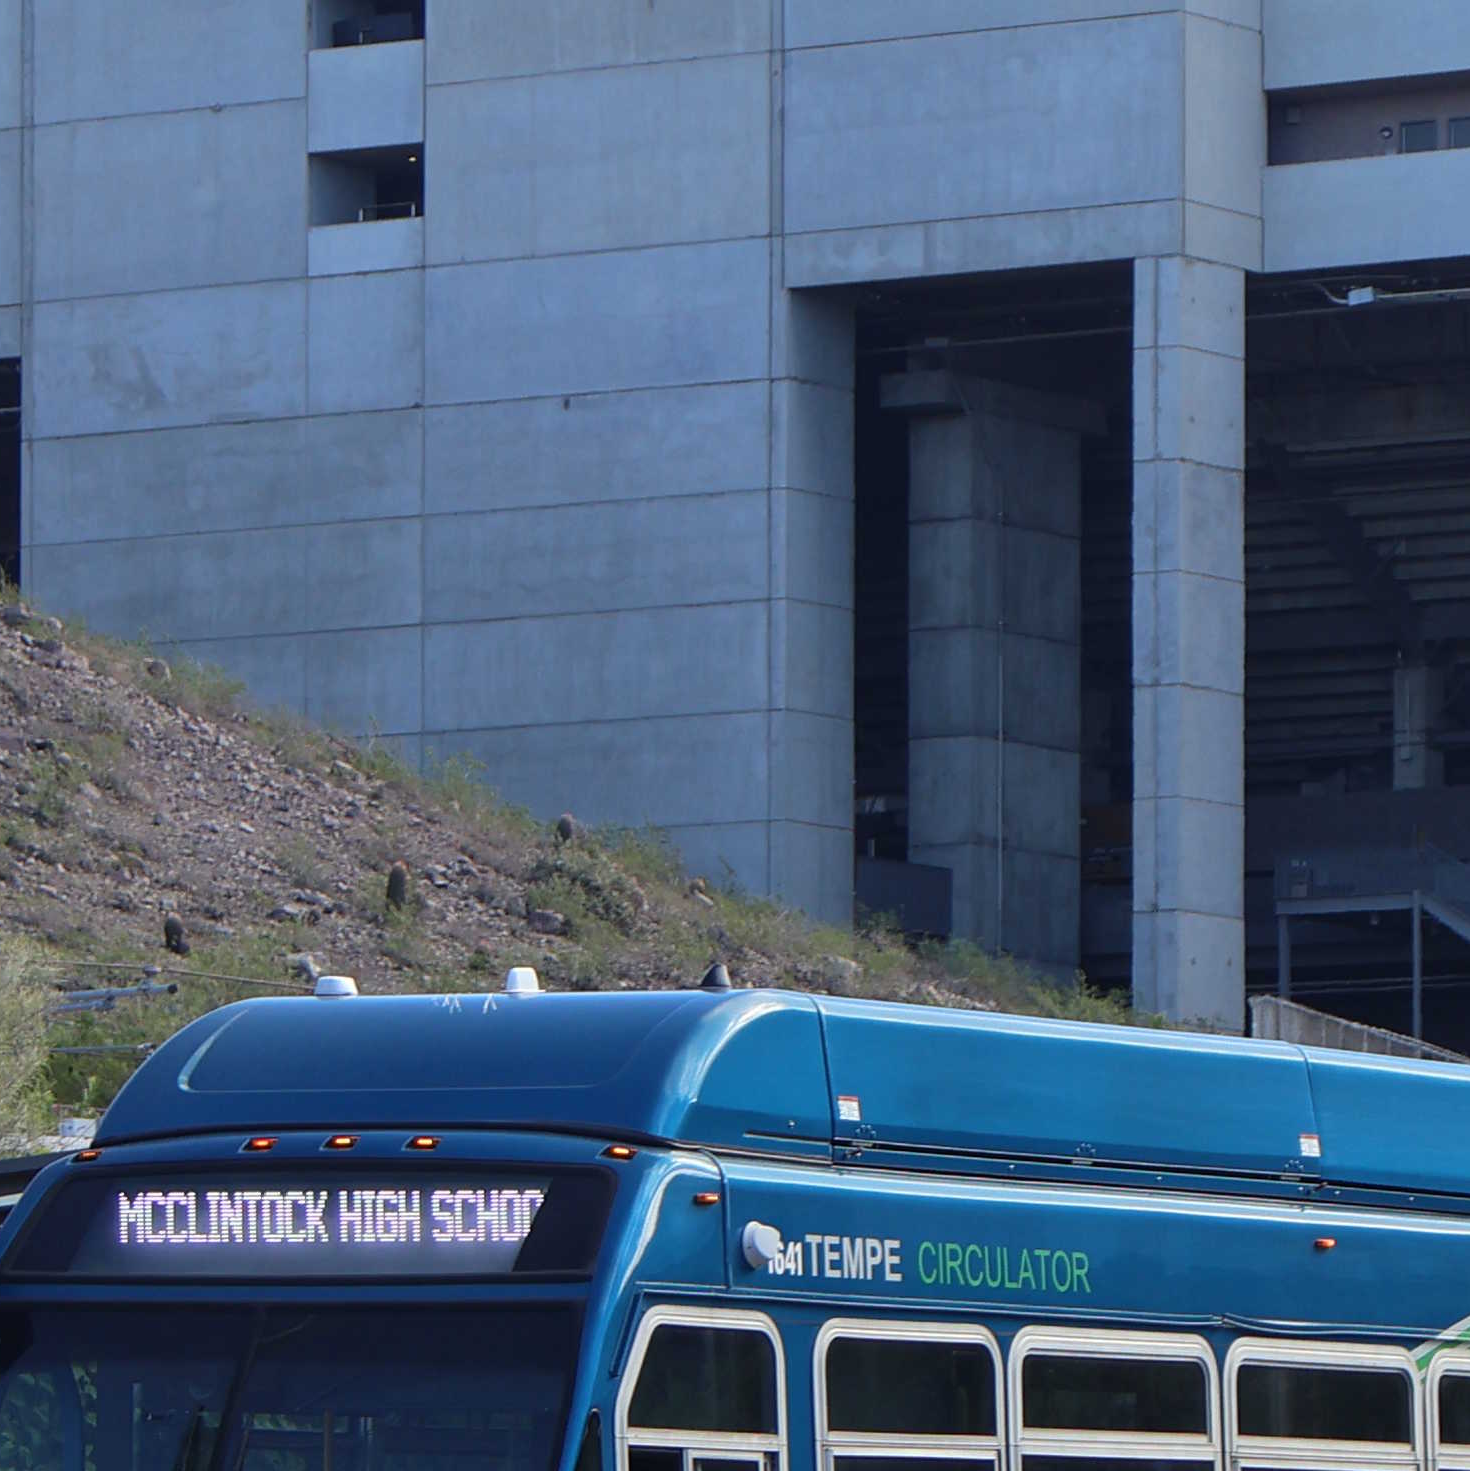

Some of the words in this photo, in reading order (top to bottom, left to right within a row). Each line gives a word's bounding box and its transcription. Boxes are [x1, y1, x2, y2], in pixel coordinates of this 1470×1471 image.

[119, 1191, 329, 1243] MCCLINTOCK
[339, 1190, 421, 1242] HIGH
[804, 1233, 903, 1282] TEMPE
[918, 1241, 1092, 1294] CIRCULATOR
